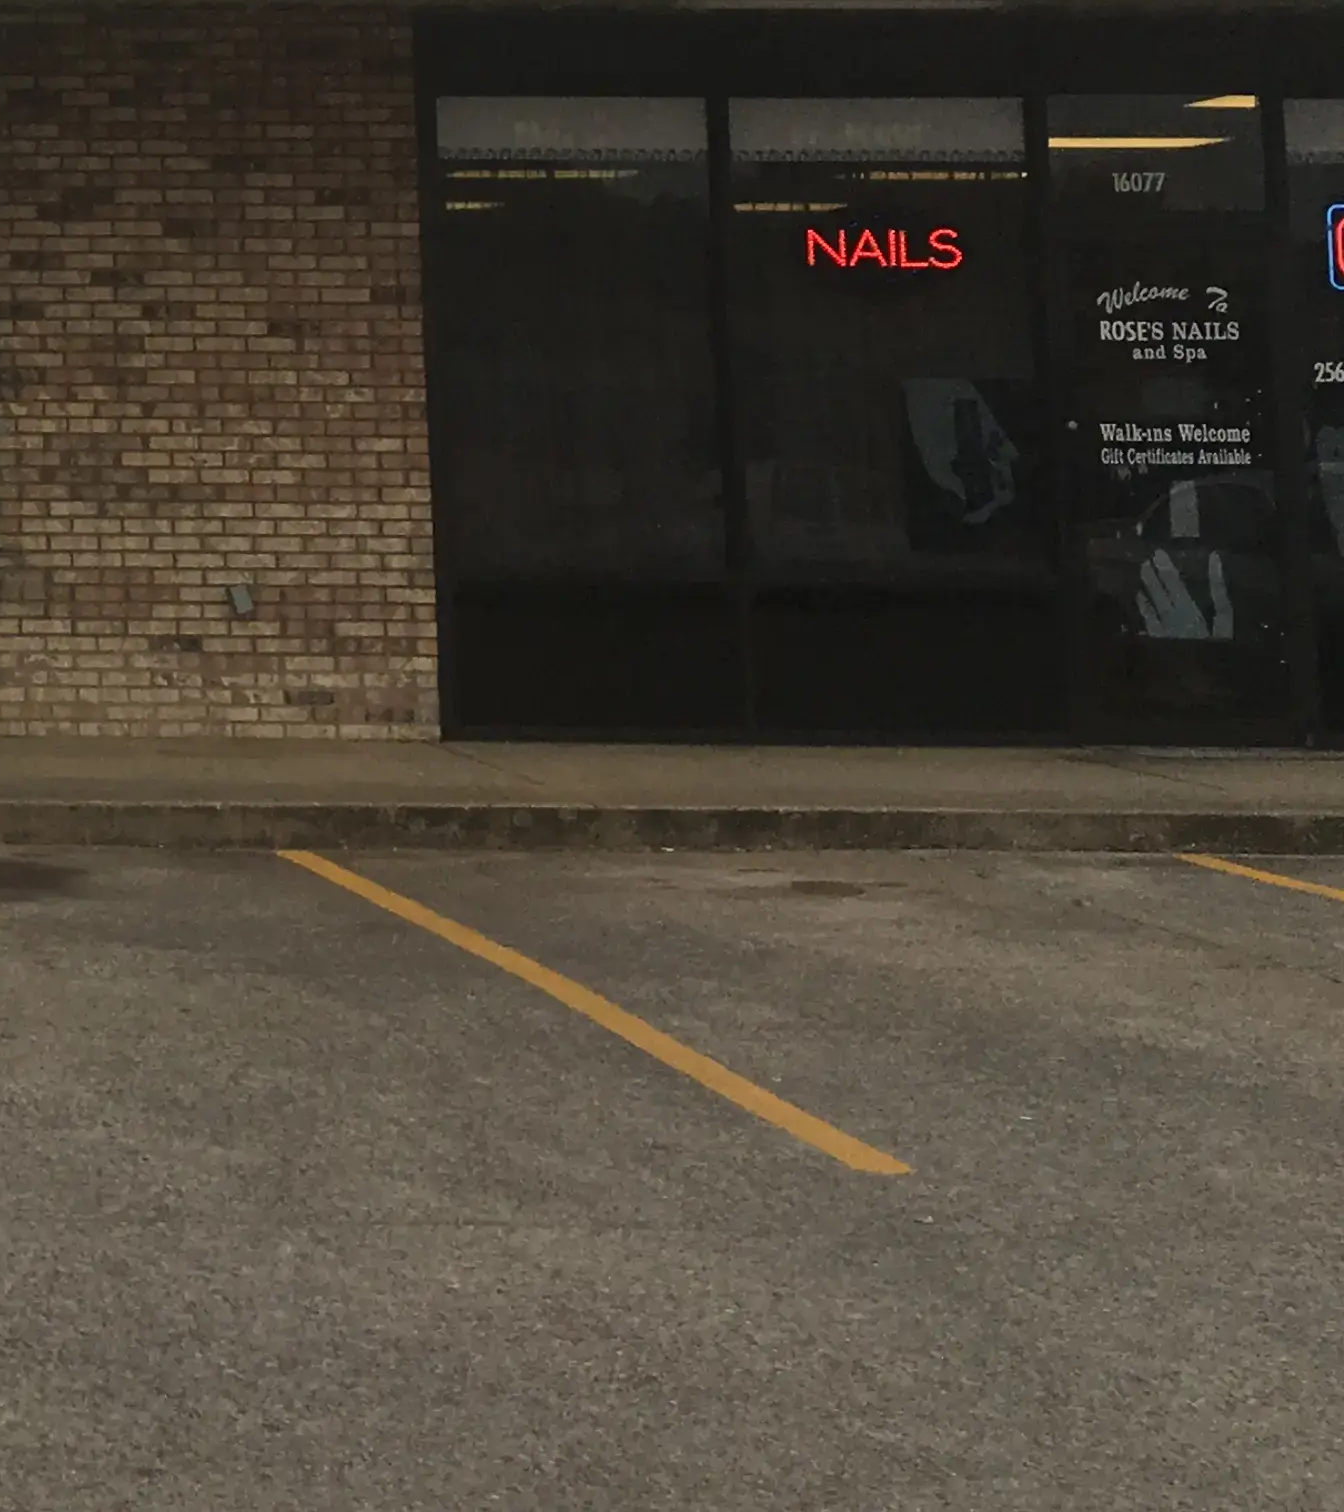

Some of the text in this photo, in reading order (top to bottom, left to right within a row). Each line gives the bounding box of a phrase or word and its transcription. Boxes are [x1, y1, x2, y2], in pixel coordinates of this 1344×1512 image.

[1112, 172, 1165, 192] 16077
[805, 226, 964, 271] NAILS
[1096, 281, 1190, 314] Welcome
[1099, 320, 1240, 342] ROSE'S NAILS
[1132, 344, 1208, 364] and Spa
[1313, 361, 1344, 383] 256
[1099, 423, 1251, 443] Walk-ins Welcome
[1100, 447, 1252, 465] Gift Certificates Available
